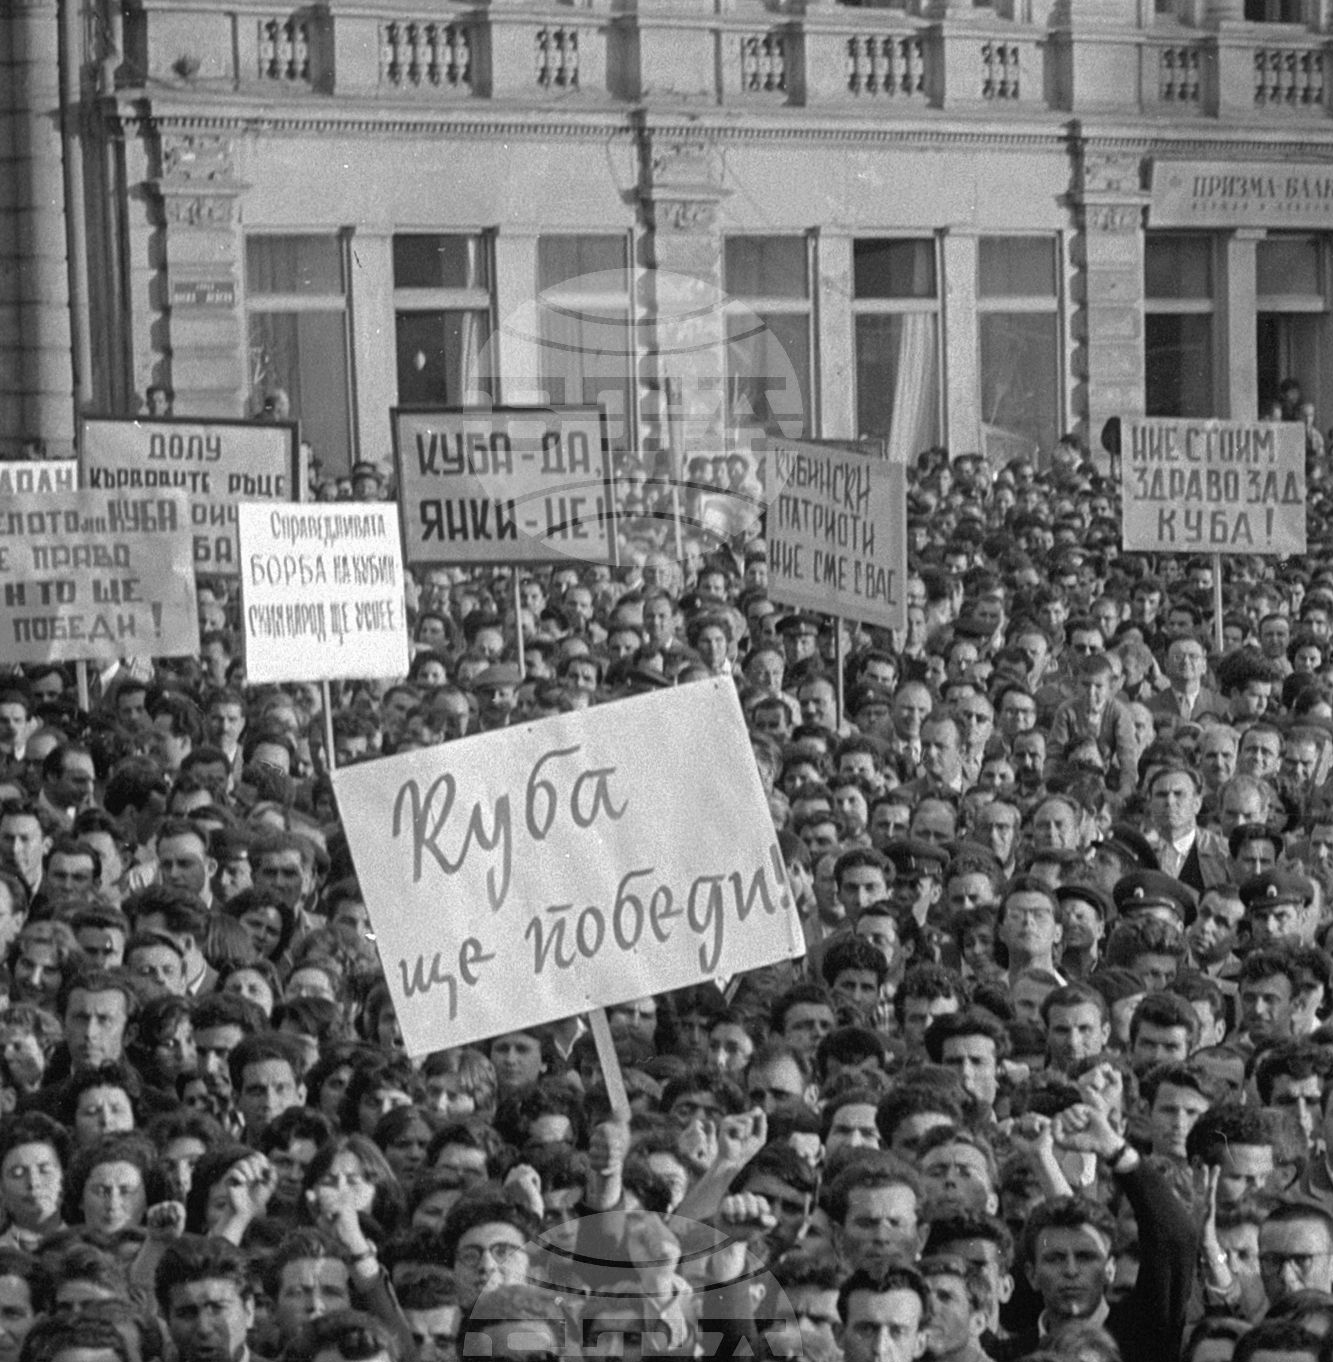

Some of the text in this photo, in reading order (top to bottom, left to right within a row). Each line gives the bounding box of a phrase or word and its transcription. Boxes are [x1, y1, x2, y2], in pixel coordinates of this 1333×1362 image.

[148, 433, 221, 462] ДОЛУ
[416, 431, 513, 476] КУБА
[1132, 425, 1276, 463] НИЕ СТОИМ
[228, 473, 285, 498] РЪЦЕ
[775, 447, 871, 517] КУБИНСКИ
[1133, 466, 1303, 505] ЗДРАВО ЗАД
[107, 499, 177, 533] КУБА
[419, 498, 518, 541] ЯНКИ
[779, 494, 875, 557] ПАТРИОТИ
[32, 543, 130, 570] ПРАВО
[250, 553, 326, 586] БОРБА
[333, 554, 352, 585] НА
[769, 539, 804, 578] НИЕ
[814, 549, 849, 591] СМЕ
[36, 581, 76, 606] ТО
[330, 602, 350, 646] ЩЕ
[392, 744, 629, 912] Куба
[399, 843, 791, 1021] ще победи!
